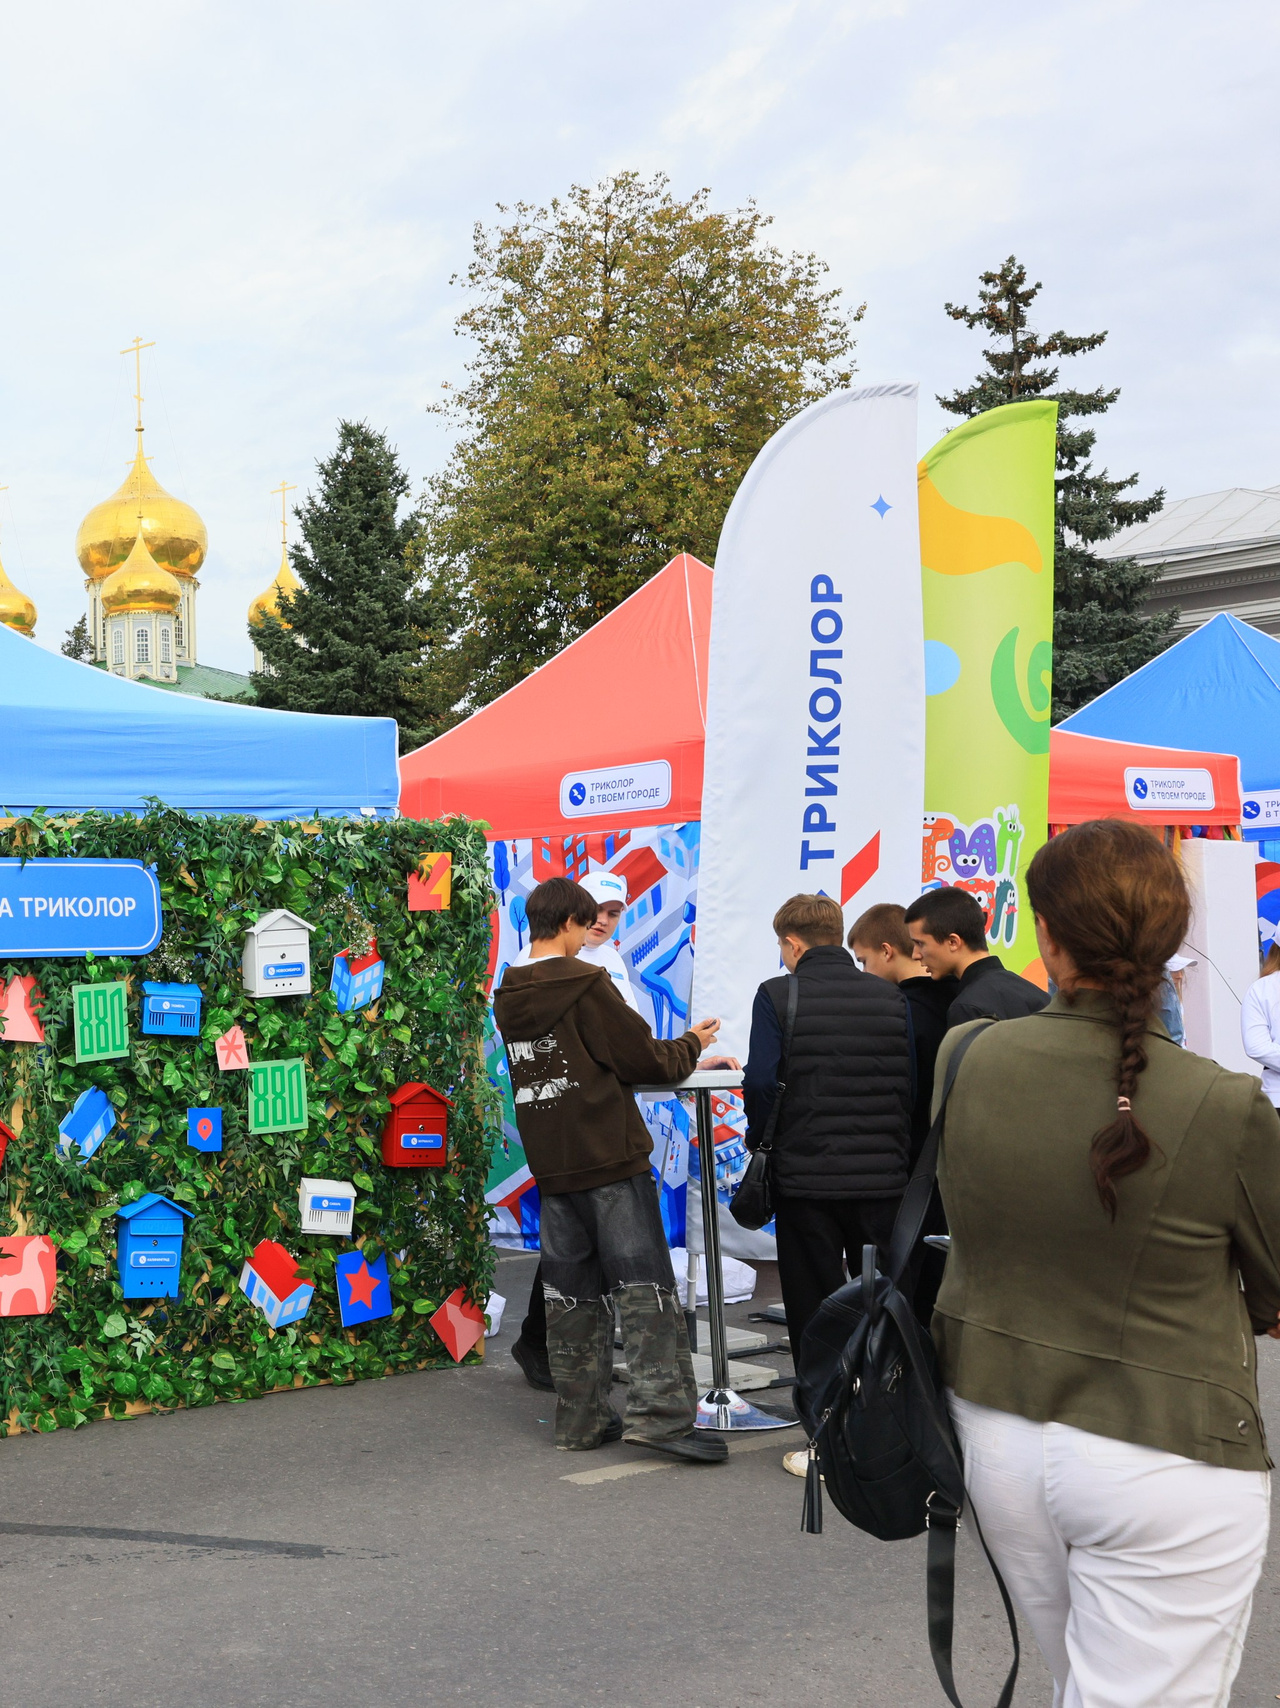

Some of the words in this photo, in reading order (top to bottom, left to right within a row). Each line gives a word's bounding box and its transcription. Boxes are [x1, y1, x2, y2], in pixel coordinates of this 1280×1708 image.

[799, 573, 844, 871] ТРИКОЛОР
[590, 777, 635, 792] ТРИКОЛОР
[1150, 780, 1186, 789] ТРИКОЛОР
[589, 795, 596, 805] В
[596, 791, 625, 803] ТВОЕМ
[626, 787, 660, 800] ГОРОДЕ
[1151, 791, 1157, 800] В
[1157, 791, 1180, 801] ТВОЕМ
[1180, 791, 1207, 801] ГОРОДЕ
[18, 896, 137, 918] ТРИКОЛОР
